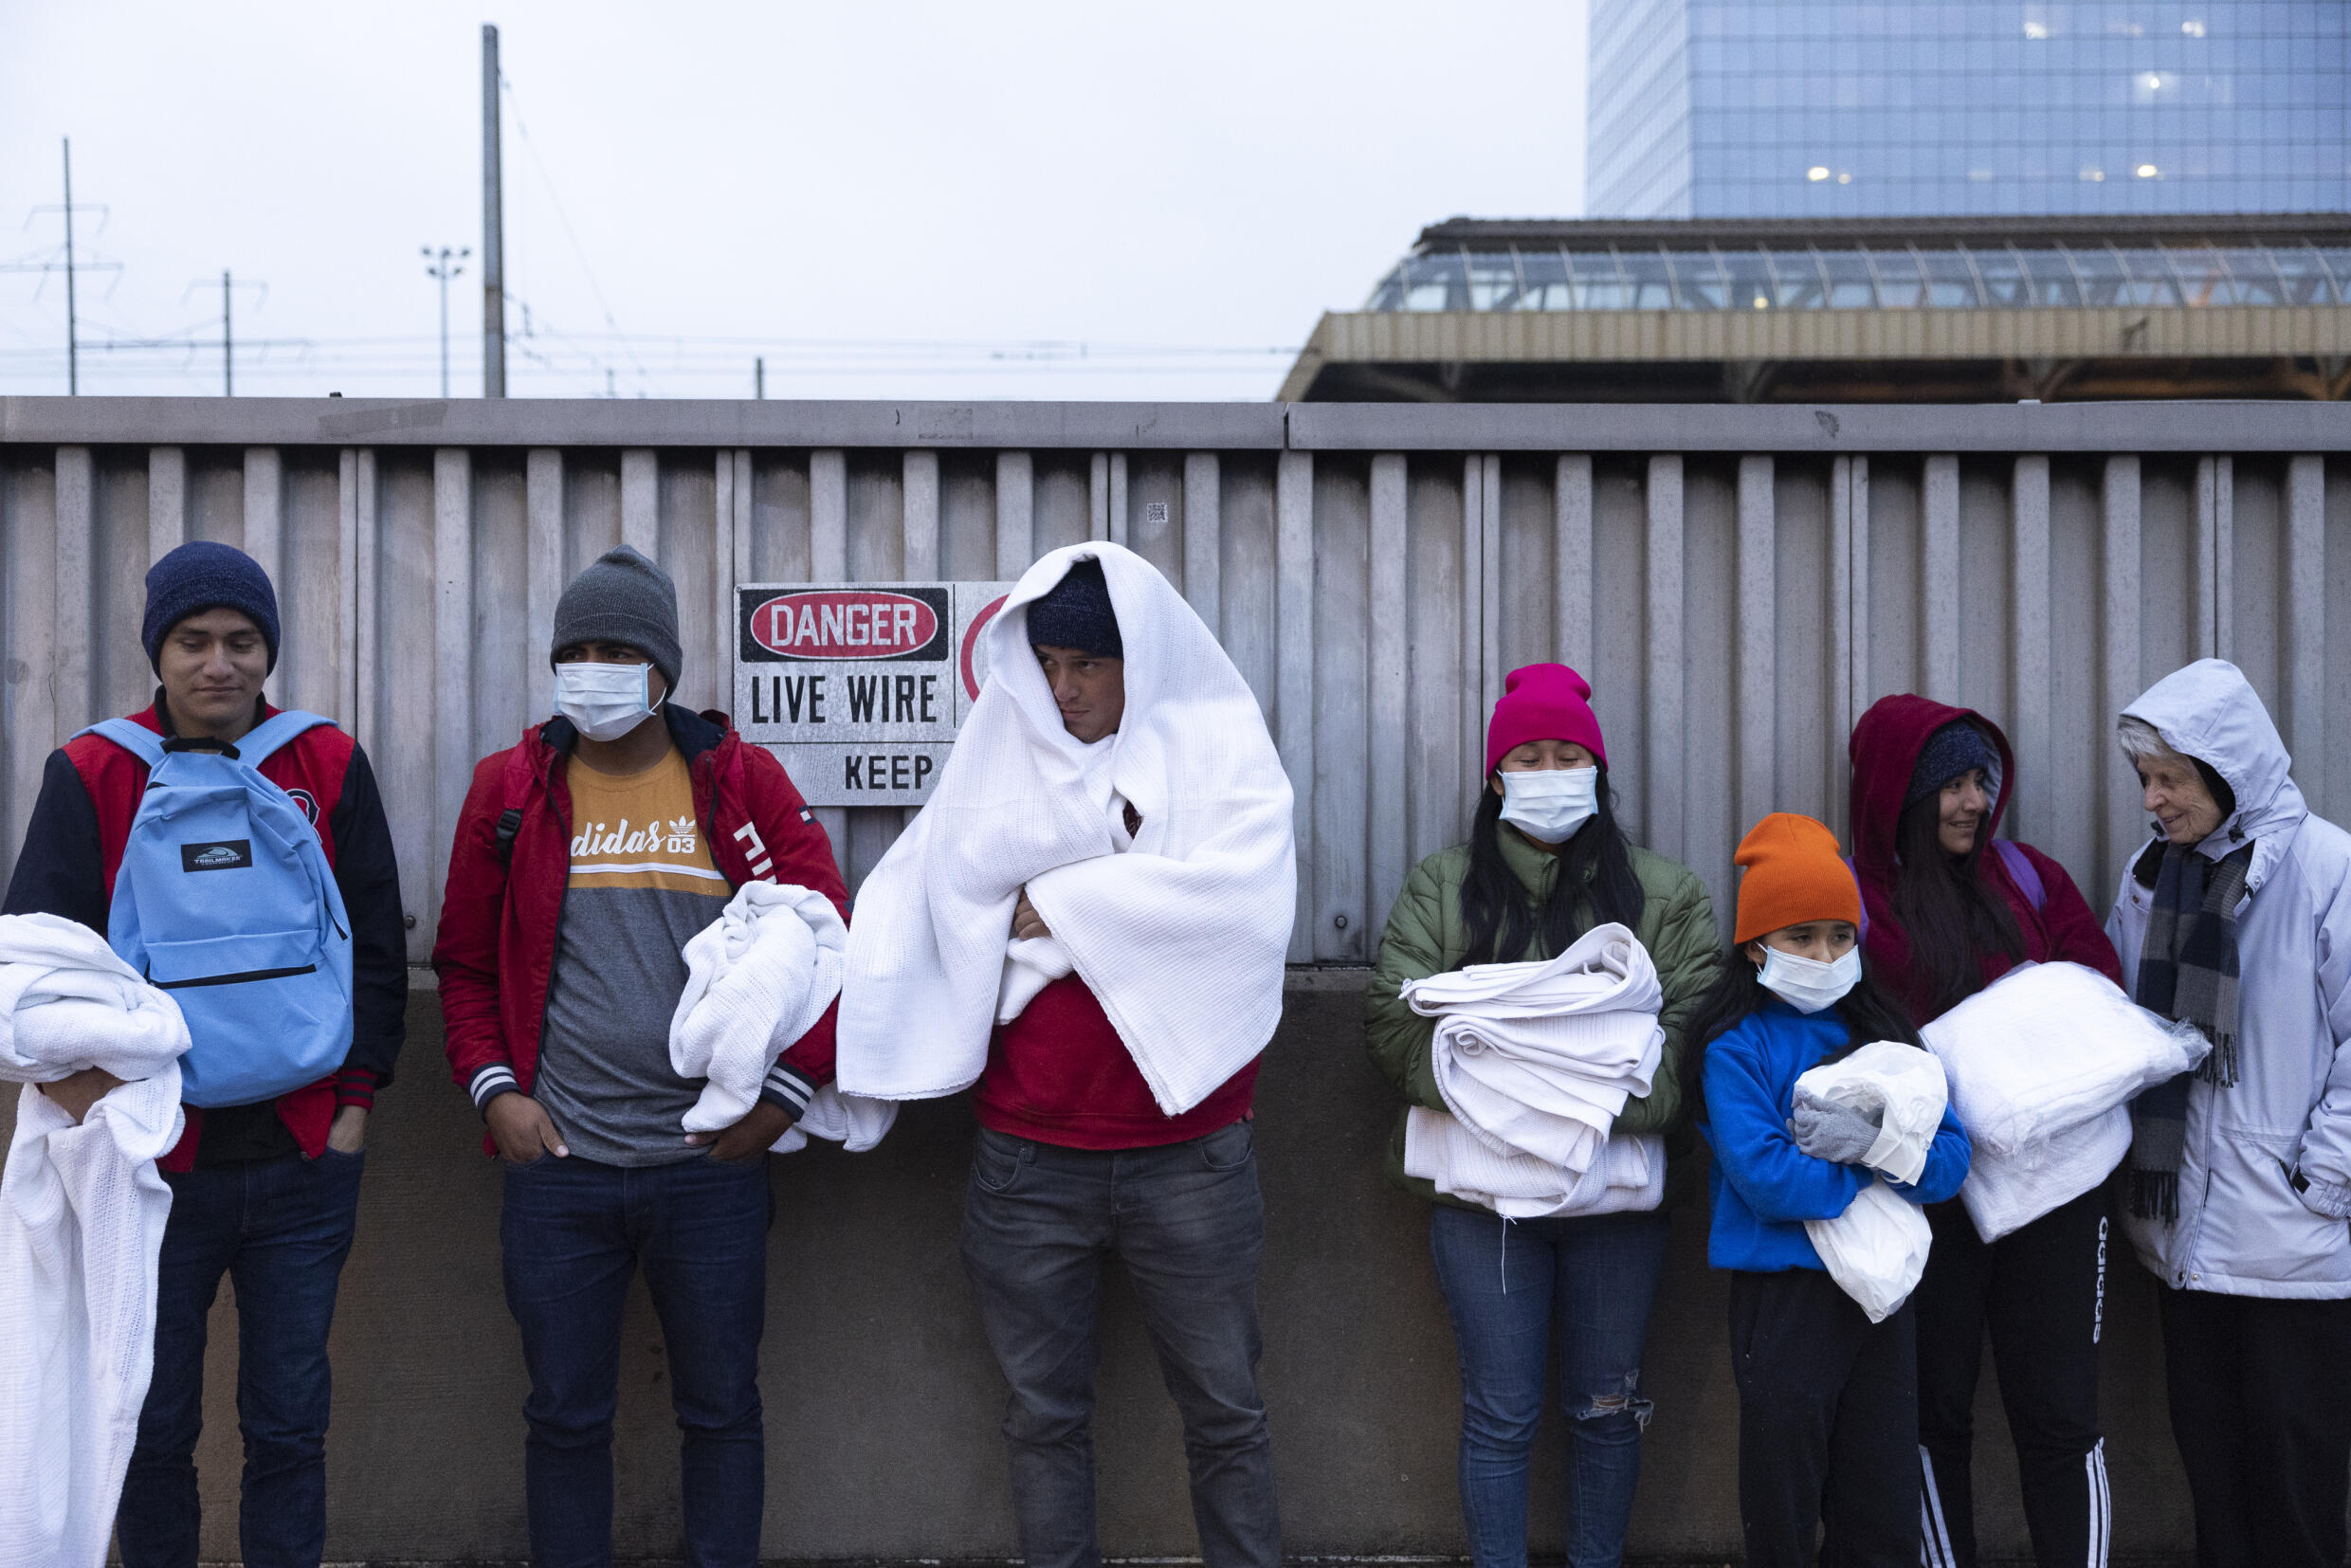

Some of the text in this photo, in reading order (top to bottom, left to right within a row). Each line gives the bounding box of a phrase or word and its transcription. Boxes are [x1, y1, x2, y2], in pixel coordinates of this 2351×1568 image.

[771, 603, 917, 647] DANGER
[752, 675, 937, 723] LIVE WIRE
[845, 756, 933, 790] KEEP
[571, 818, 666, 856] didas
[667, 837, 695, 853] 03
